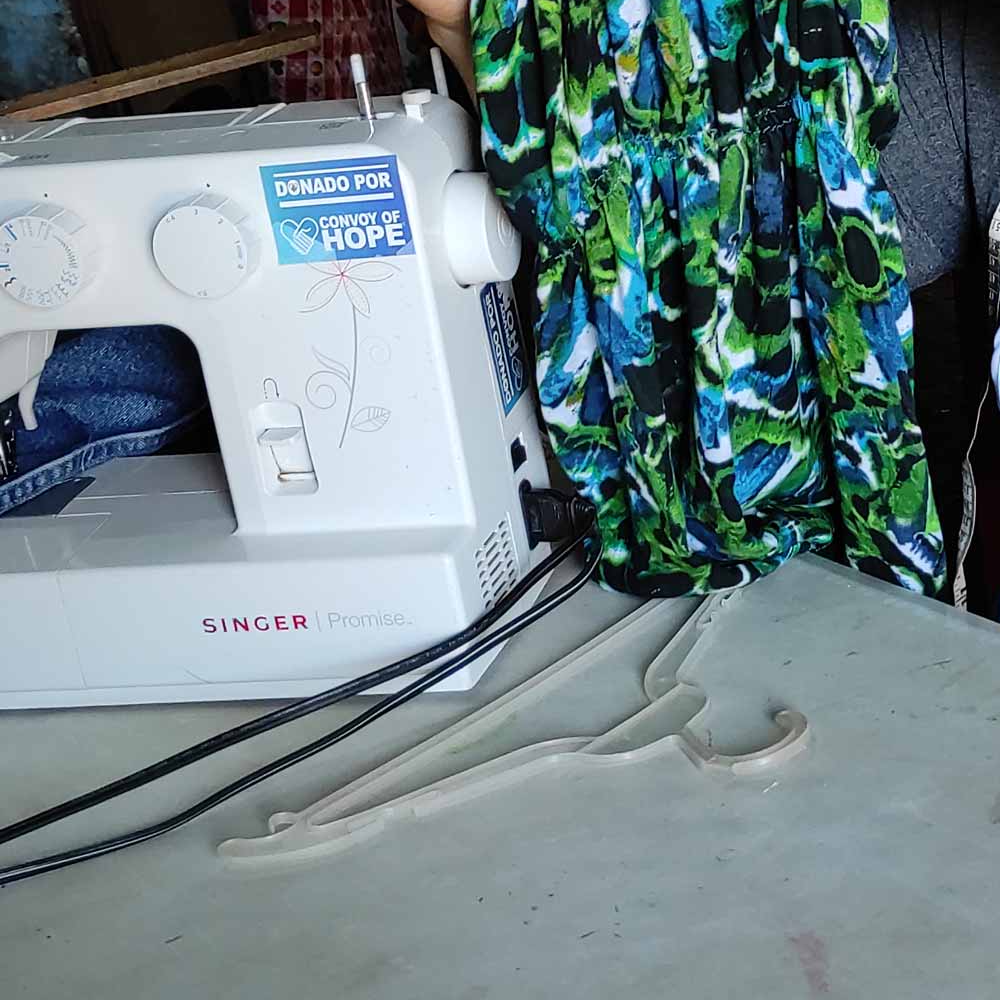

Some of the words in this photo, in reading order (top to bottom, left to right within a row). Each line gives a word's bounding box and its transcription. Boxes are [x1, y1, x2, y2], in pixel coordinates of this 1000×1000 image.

[274, 175, 350, 197] DONADO
[354, 172, 392, 191] POR
[319, 211, 378, 229] CONVOY
[381, 210, 400, 224] OF
[321, 223, 407, 251] HOPE
[485, 291, 497, 329] POR
[492, 330, 512, 405] DONADO
[202, 614, 309, 634] SINGER
[327, 609, 406, 630] Promise
